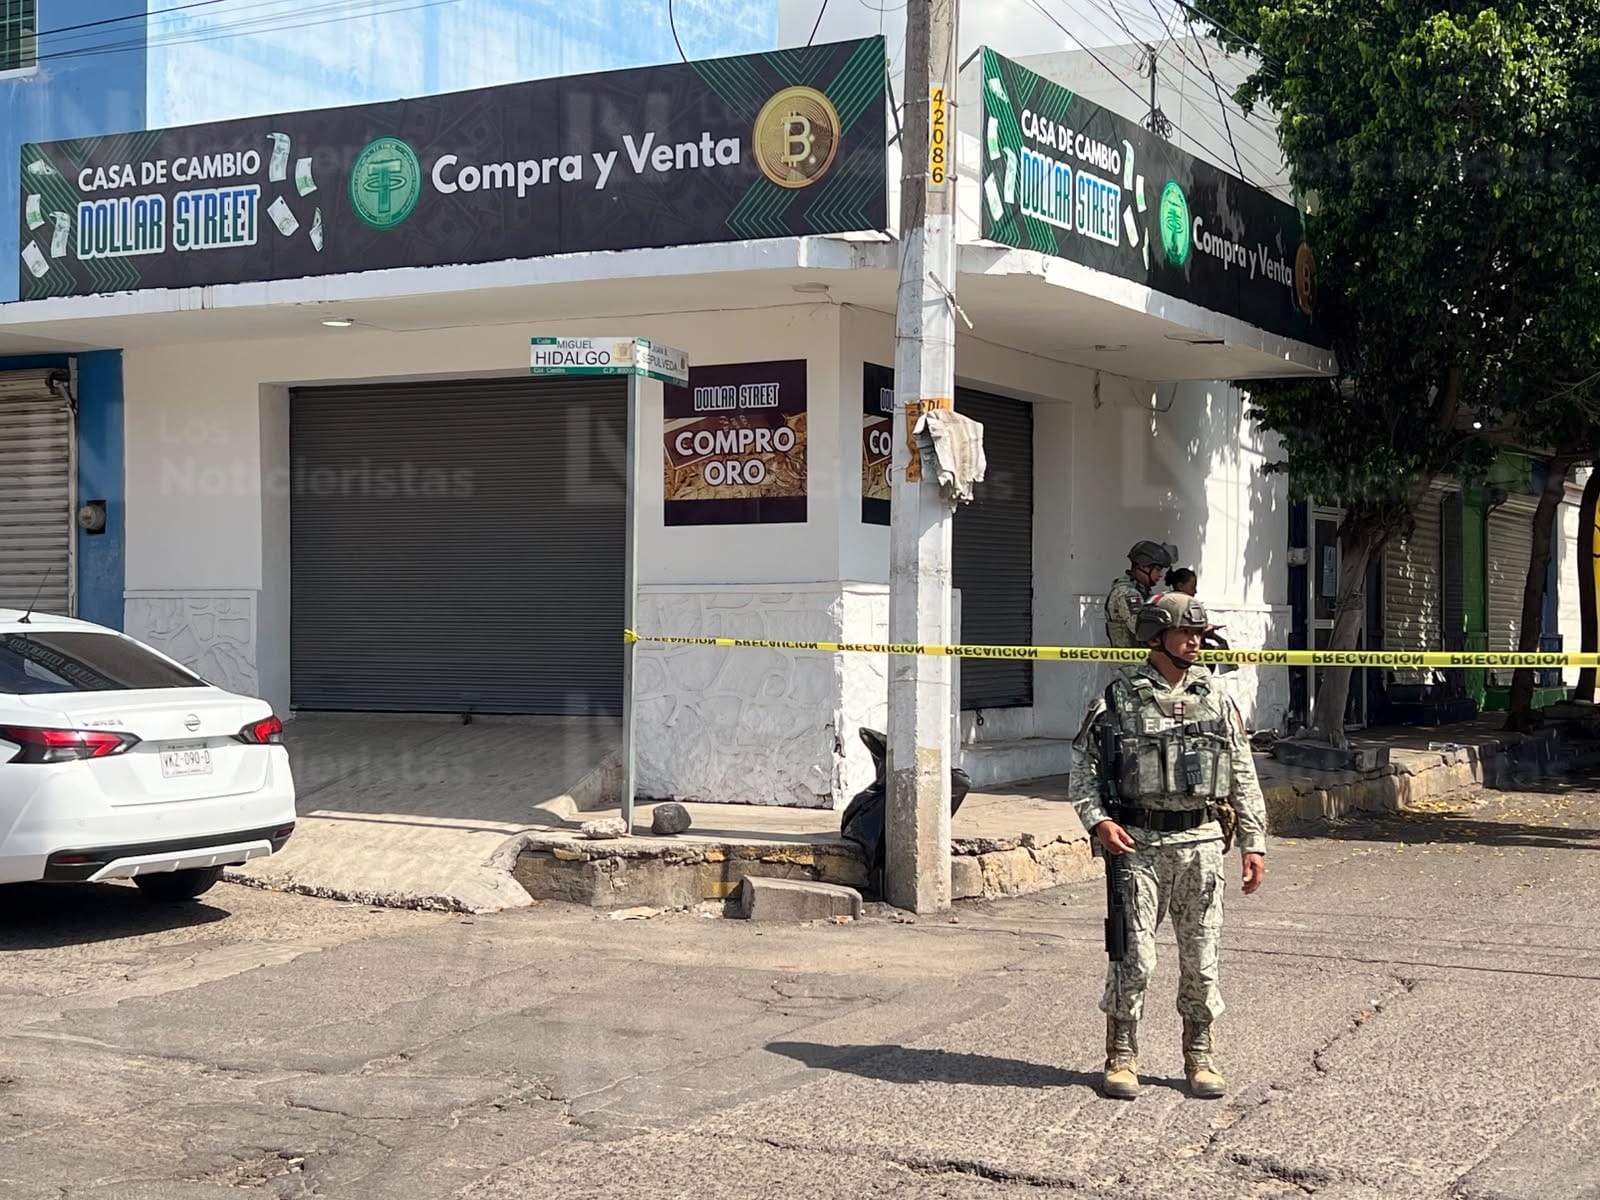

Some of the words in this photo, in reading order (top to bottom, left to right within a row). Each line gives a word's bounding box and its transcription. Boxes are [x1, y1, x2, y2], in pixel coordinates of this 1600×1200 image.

[932, 89, 944, 184] 42086
[1021, 109, 1056, 149] CASA
[1058, 124, 1074, 156] DE
[1075, 133, 1121, 175] CAMBIO
[78, 163, 137, 192] CASA
[141, 159, 168, 186] DE
[171, 150, 261, 182] CAMBIO
[431, 154, 583, 198] Compra
[592, 151, 618, 190] y
[622, 132, 741, 174] Venta
[77, 194, 166, 260] DOLLAR
[173, 184, 261, 251] STREET
[1021, 146, 1073, 231] DOLLAR
[1075, 170, 1121, 247] STREET
[1192, 216, 1247, 270] Compra
[1248, 250, 1258, 280] y
[1258, 243, 1293, 287] Venta
[535, 350, 611, 366] HIDALGO
[557, 340, 594, 349] MIGUEL
[694, 386, 737, 412] DOLLAR
[739, 382, 780, 409] STREET
[675, 426, 796, 456] COMPRO
[703, 459, 766, 486] ORO
